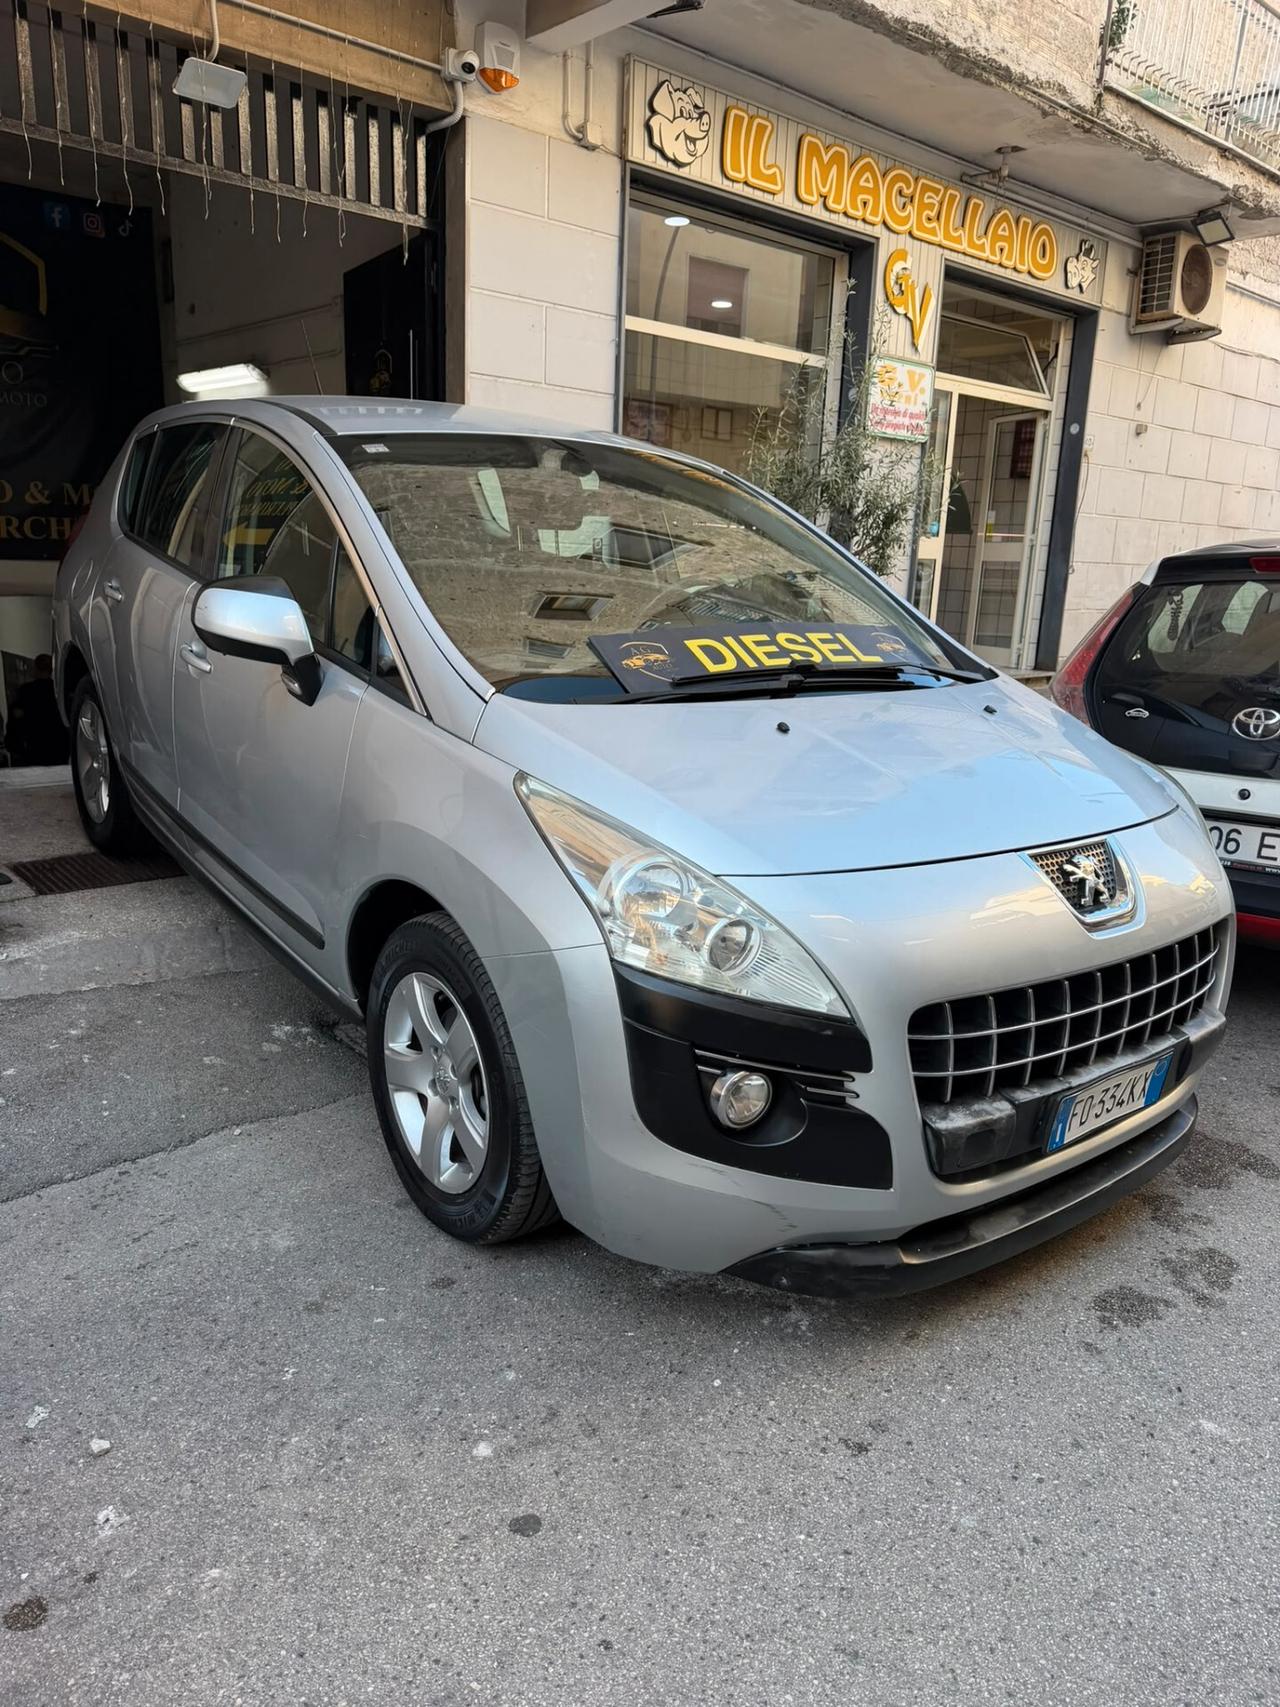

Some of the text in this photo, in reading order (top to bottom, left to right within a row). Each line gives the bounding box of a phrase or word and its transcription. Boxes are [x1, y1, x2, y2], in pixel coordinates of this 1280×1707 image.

[723, 105, 1057, 280] IL MACELLAIO
[683, 632, 884, 673] DIESEL
